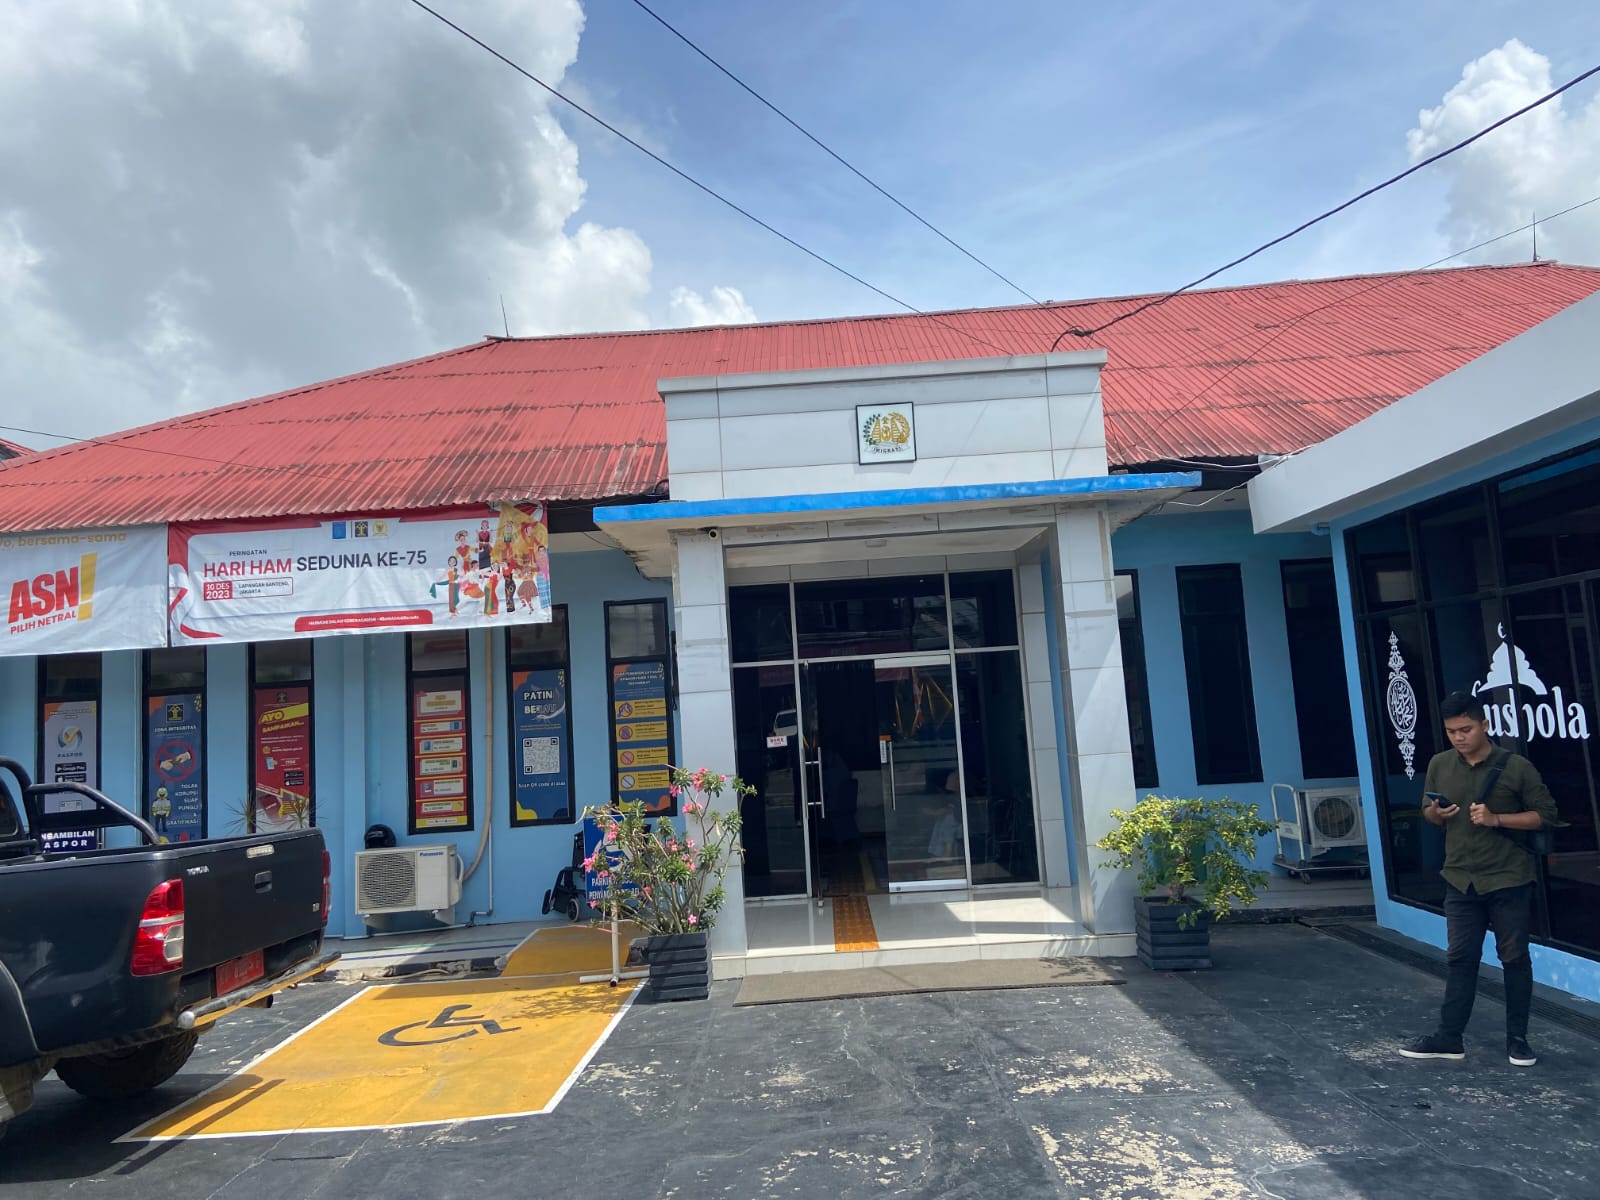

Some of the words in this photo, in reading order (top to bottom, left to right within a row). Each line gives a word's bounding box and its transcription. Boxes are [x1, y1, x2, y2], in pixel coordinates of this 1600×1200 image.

[18, 533, 127, 547] bersama-sama
[229, 549, 267, 557] PERINGATAN
[204, 560, 245, 577] HARI
[250, 558, 292, 575] HAM
[296, 552, 373, 572] SEDUNIA
[377, 550, 427, 567] KE-75
[206, 590, 230, 599] 2023
[10, 620, 36, 635] PILIH
[37, 610, 76, 628] NETRAL
[524, 690, 553, 701] PATIN
[261, 711, 284, 723] AYO
